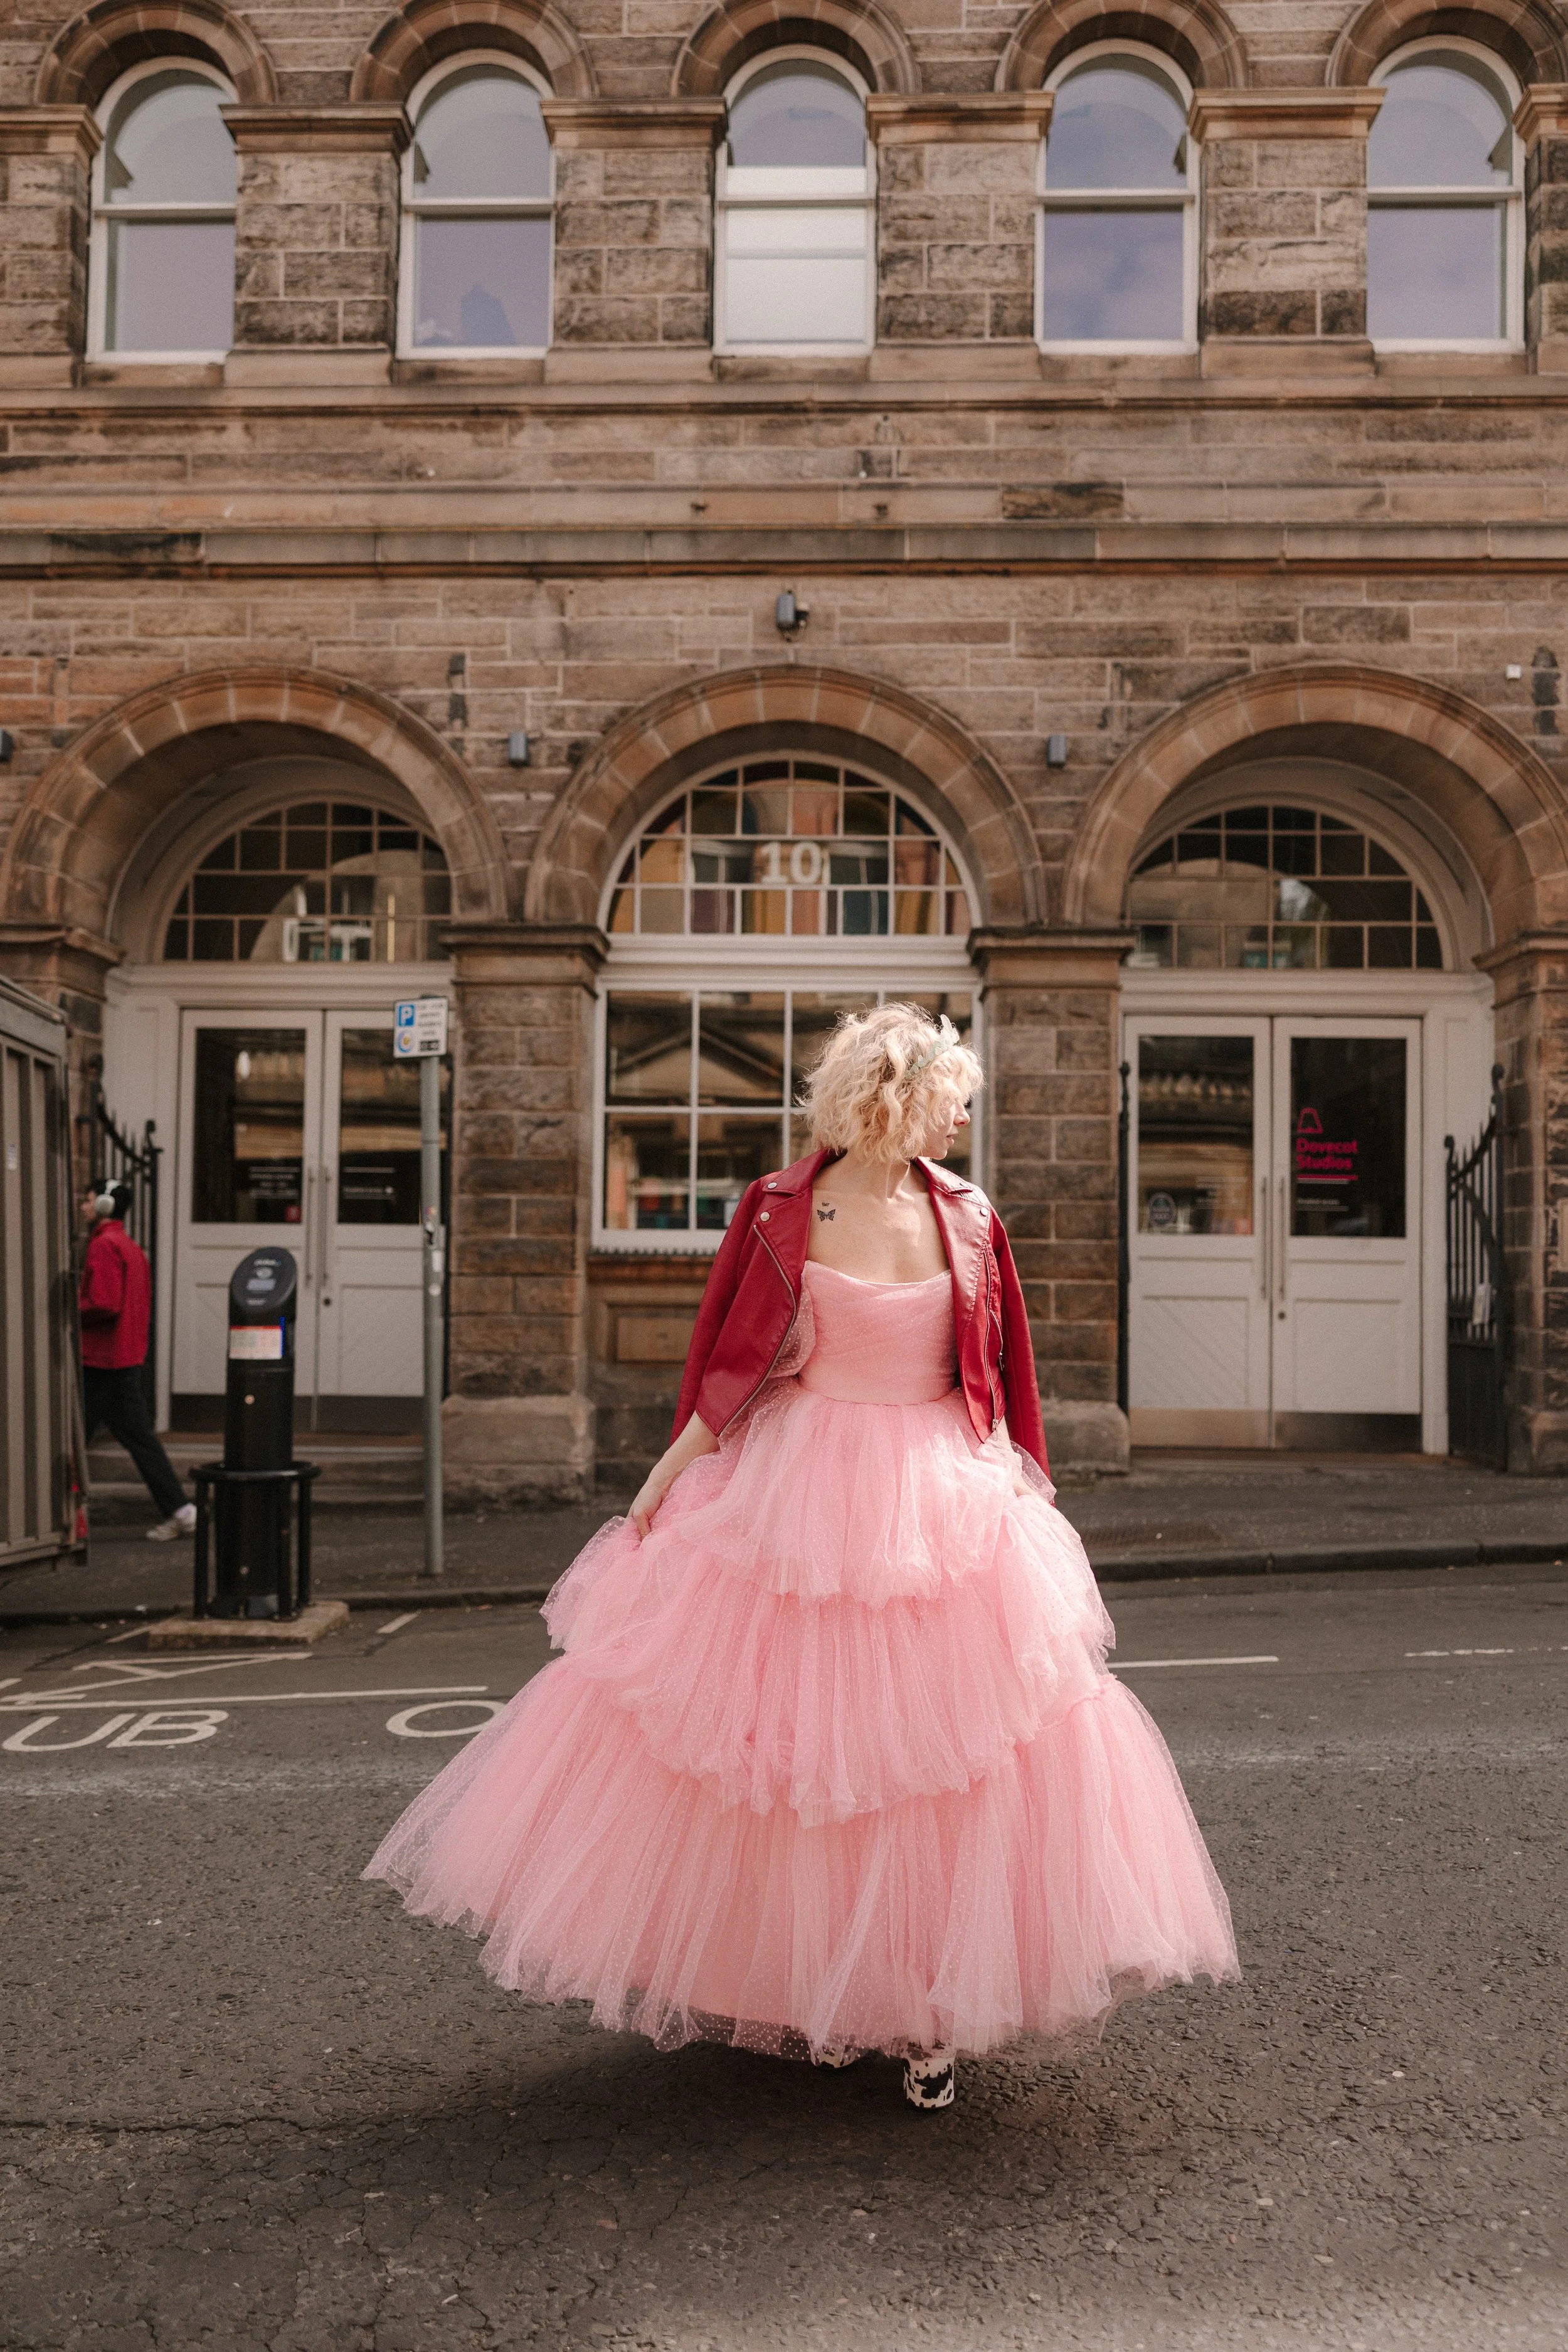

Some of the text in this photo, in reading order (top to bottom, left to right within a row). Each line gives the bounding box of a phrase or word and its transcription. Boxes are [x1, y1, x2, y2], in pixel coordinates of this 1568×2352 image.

[760, 841, 822, 884] 10
[1296, 1155, 1353, 1169] Studios
[2, 1710, 230, 1752] UB
